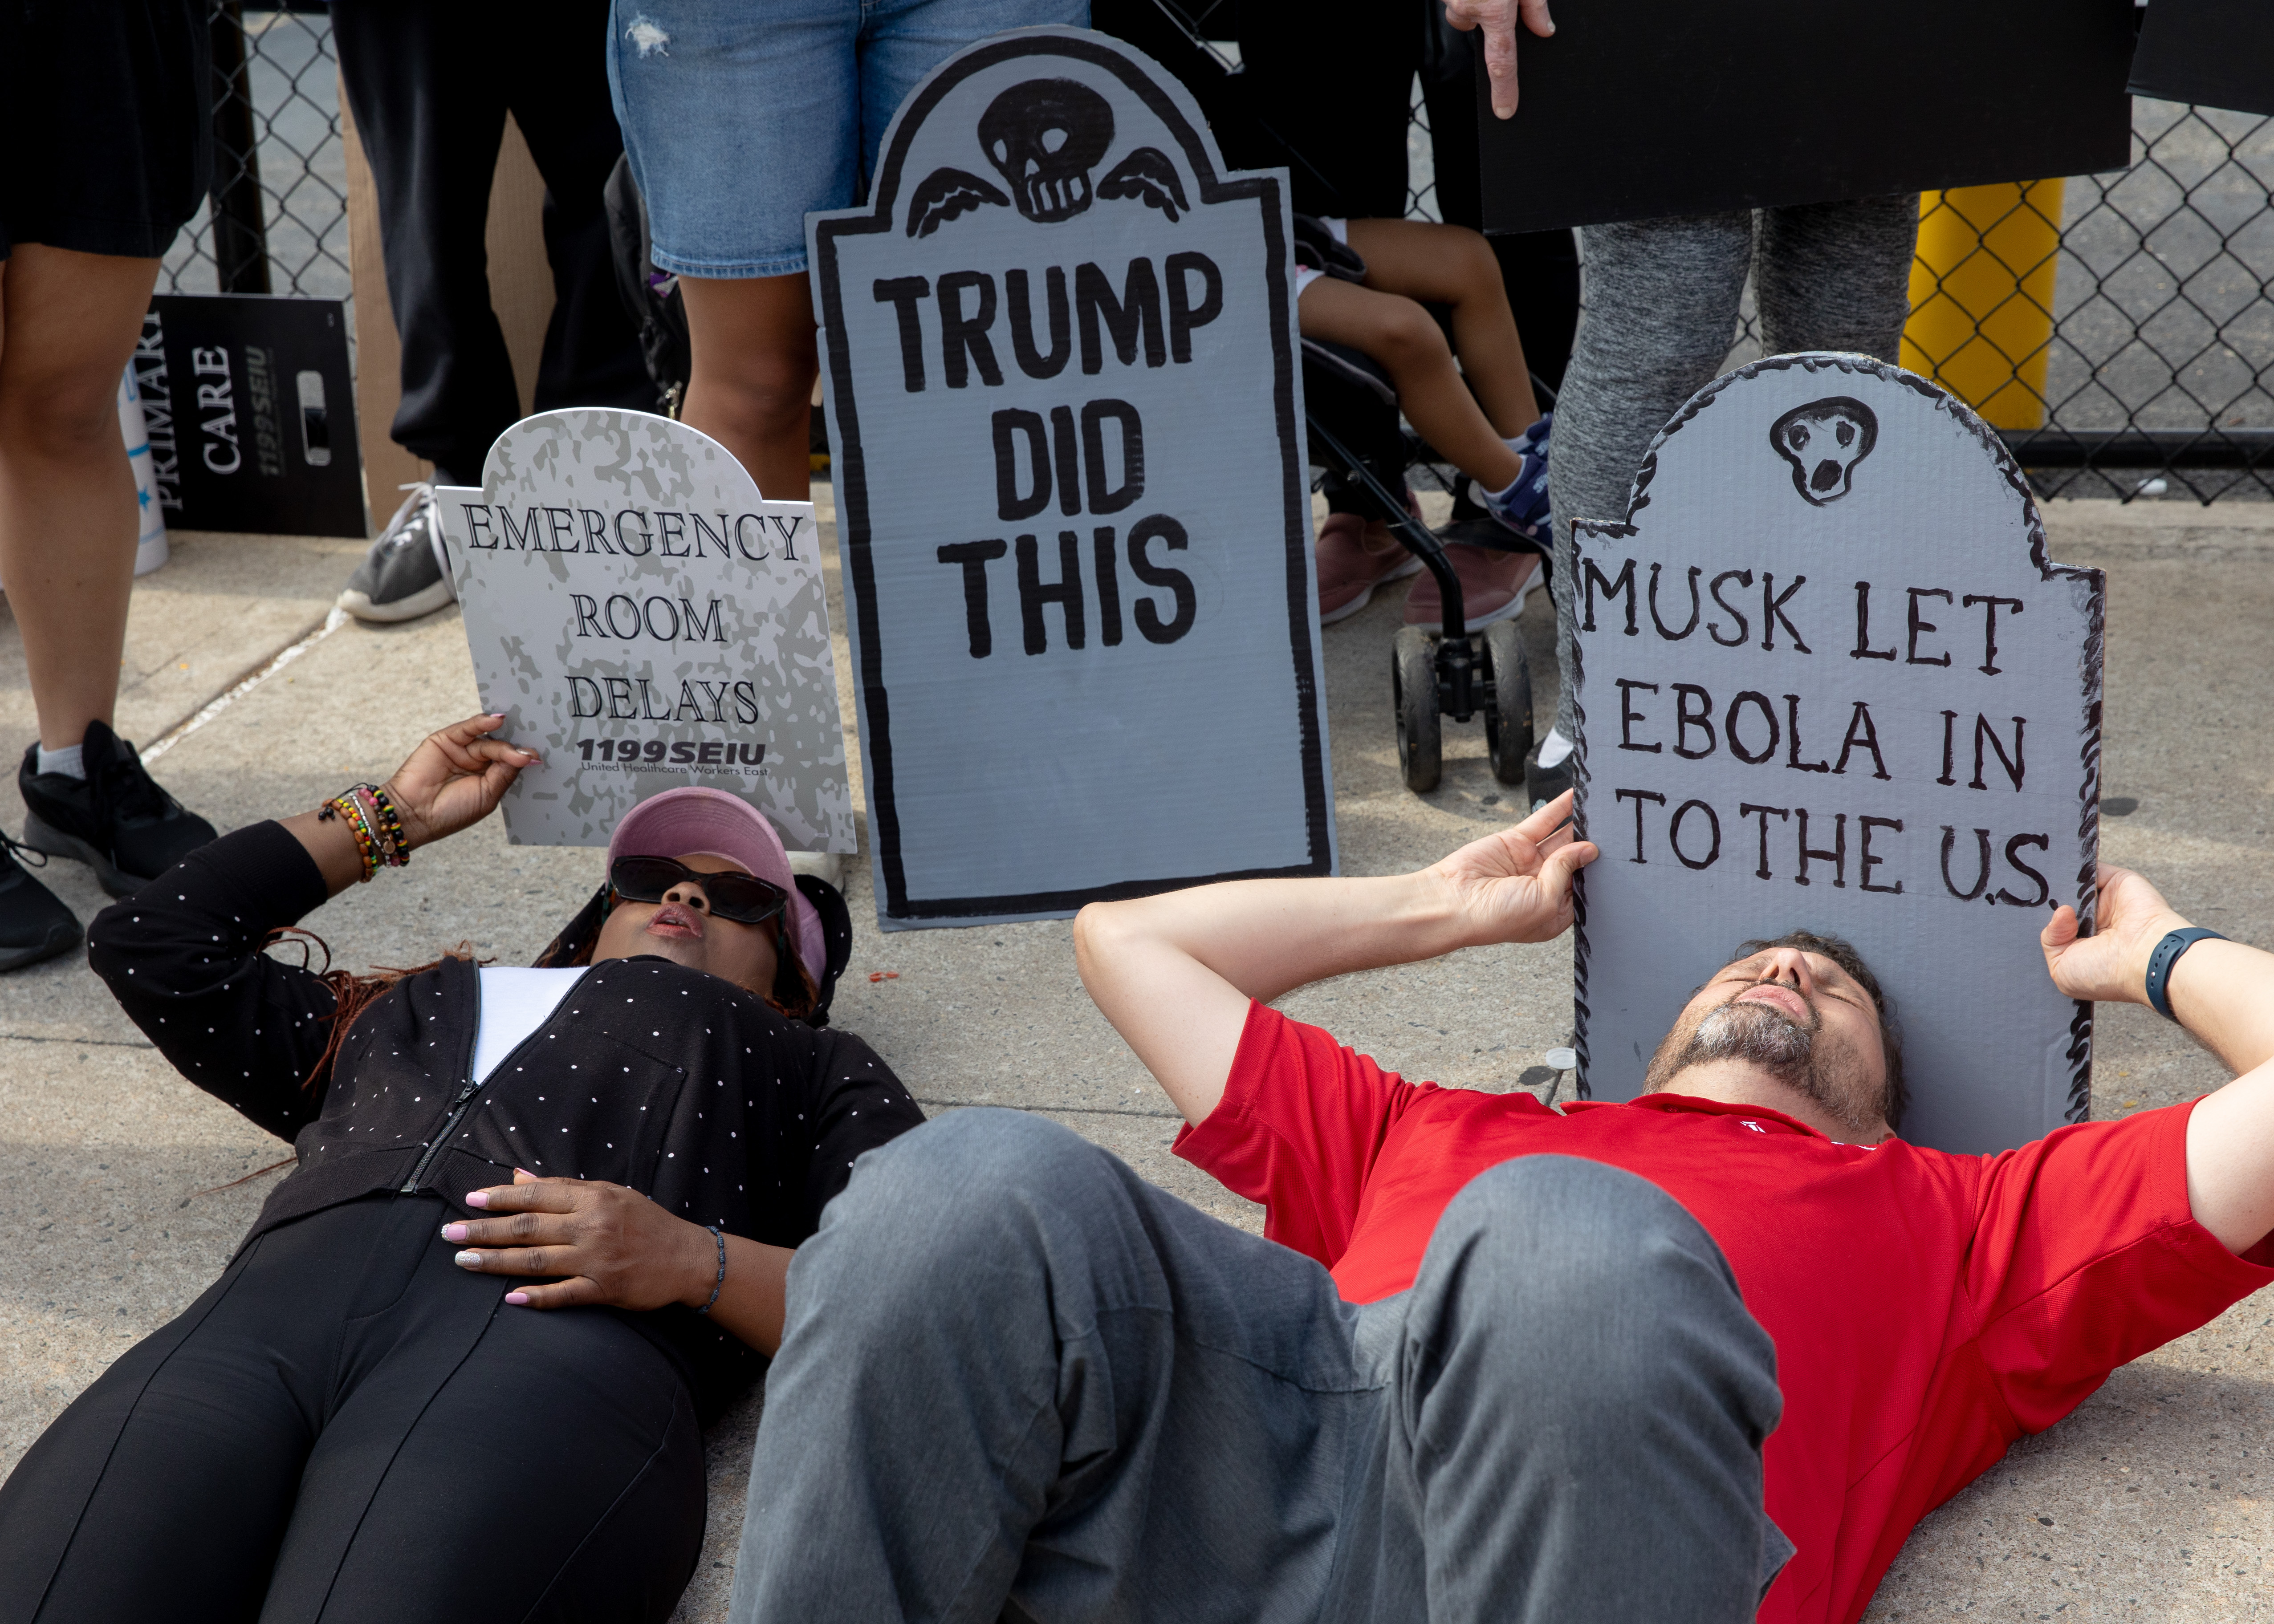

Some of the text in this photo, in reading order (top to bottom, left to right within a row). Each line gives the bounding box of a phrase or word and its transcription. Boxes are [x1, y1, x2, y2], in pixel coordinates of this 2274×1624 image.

[873, 252, 1224, 393] TRUMP
[192, 345, 241, 475] CARE
[992, 398, 1145, 522] DID
[460, 503, 804, 561] EMERGENCY
[937, 513, 1197, 660] THIS
[569, 594, 728, 642] ROOM
[1581, 557, 2024, 676] MUSK LET
[565, 676, 759, 724] DELAYS
[576, 739, 766, 765] 1199SEIU
[1615, 678, 2027, 793] EBOLA IN
[581, 762, 769, 776] United Healthcare Workers East
[1615, 788, 2059, 911] TO THE U.S.
